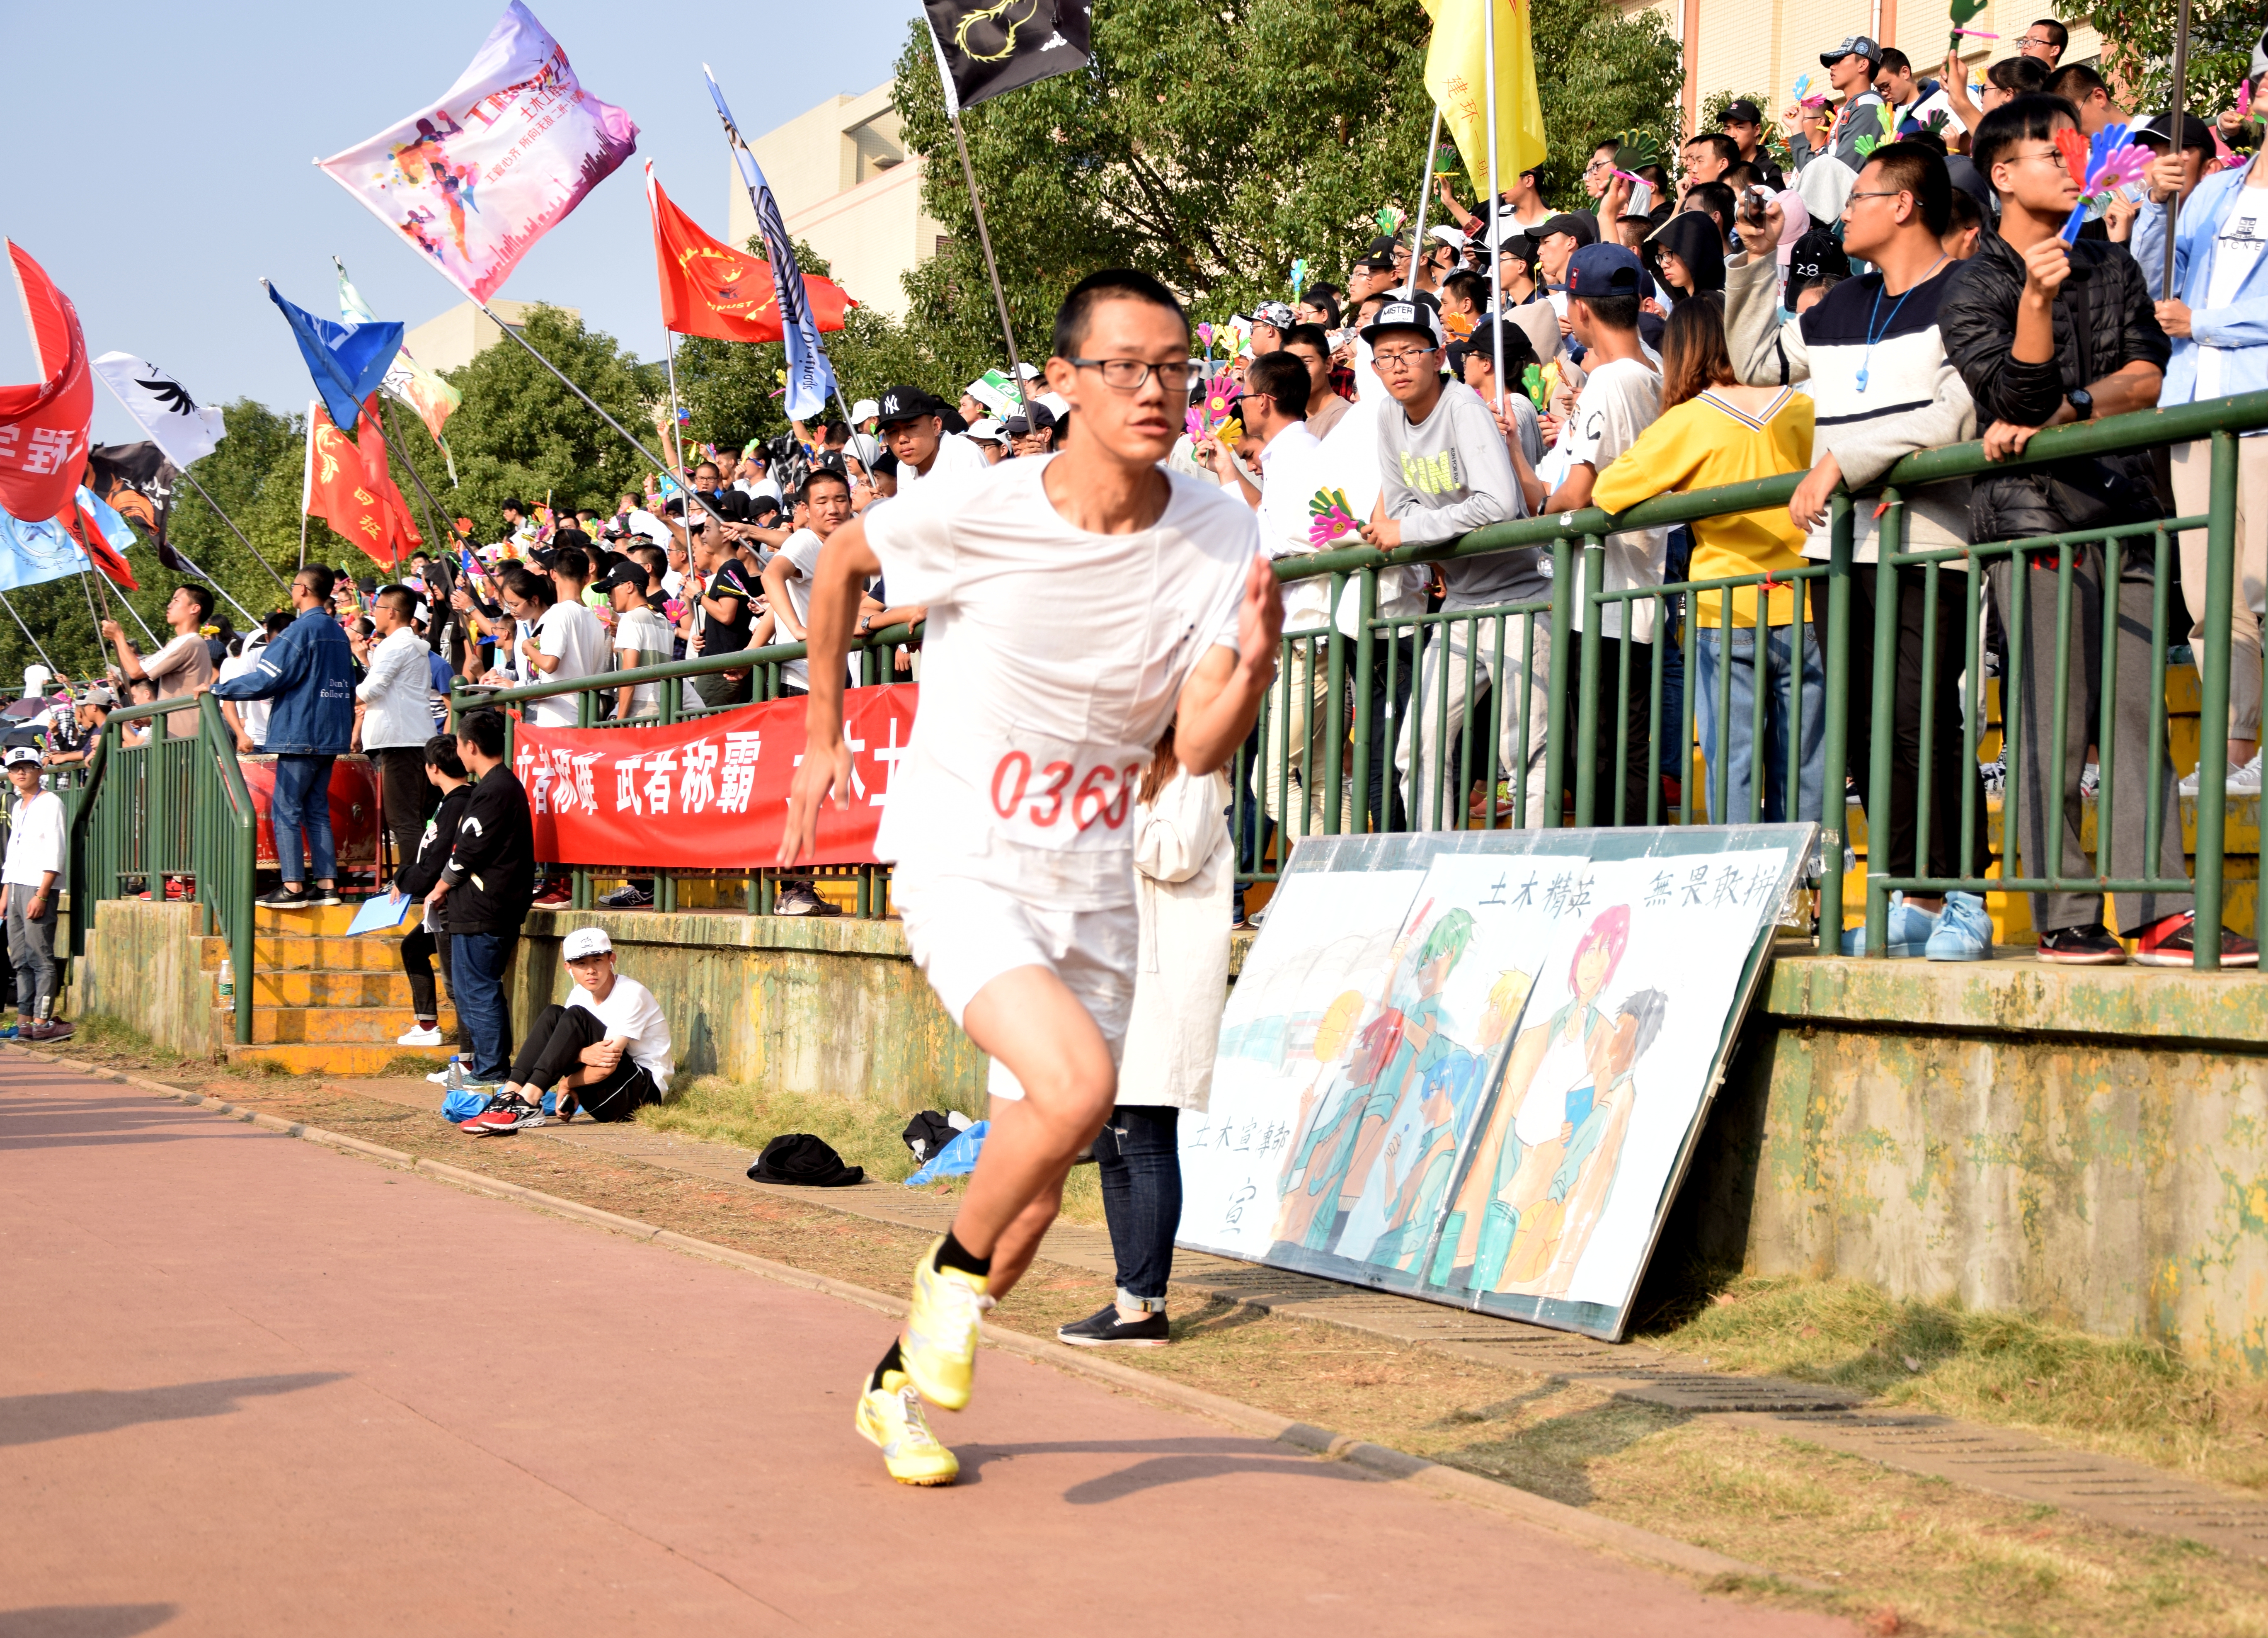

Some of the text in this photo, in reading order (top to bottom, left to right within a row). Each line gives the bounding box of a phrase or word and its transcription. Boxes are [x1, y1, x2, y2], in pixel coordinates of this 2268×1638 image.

[484, 147, 521, 184] 工管心齐
[519, 115, 556, 149] 所向无敌
[1441, 75, 1488, 182] 建环一班
[1796, 263, 1819, 277] 28
[1260, 309, 1268, 320] 3
[1383, 306, 1413, 316] MISTER
[884, 394, 900, 414] NY
[354, 486, 382, 541] 四班
[615, 731, 761, 815] 武者称霸
[1478, 864, 1776, 920] 土木精英 無畏敢拼
[1217, 1177, 1257, 1235] 宣
